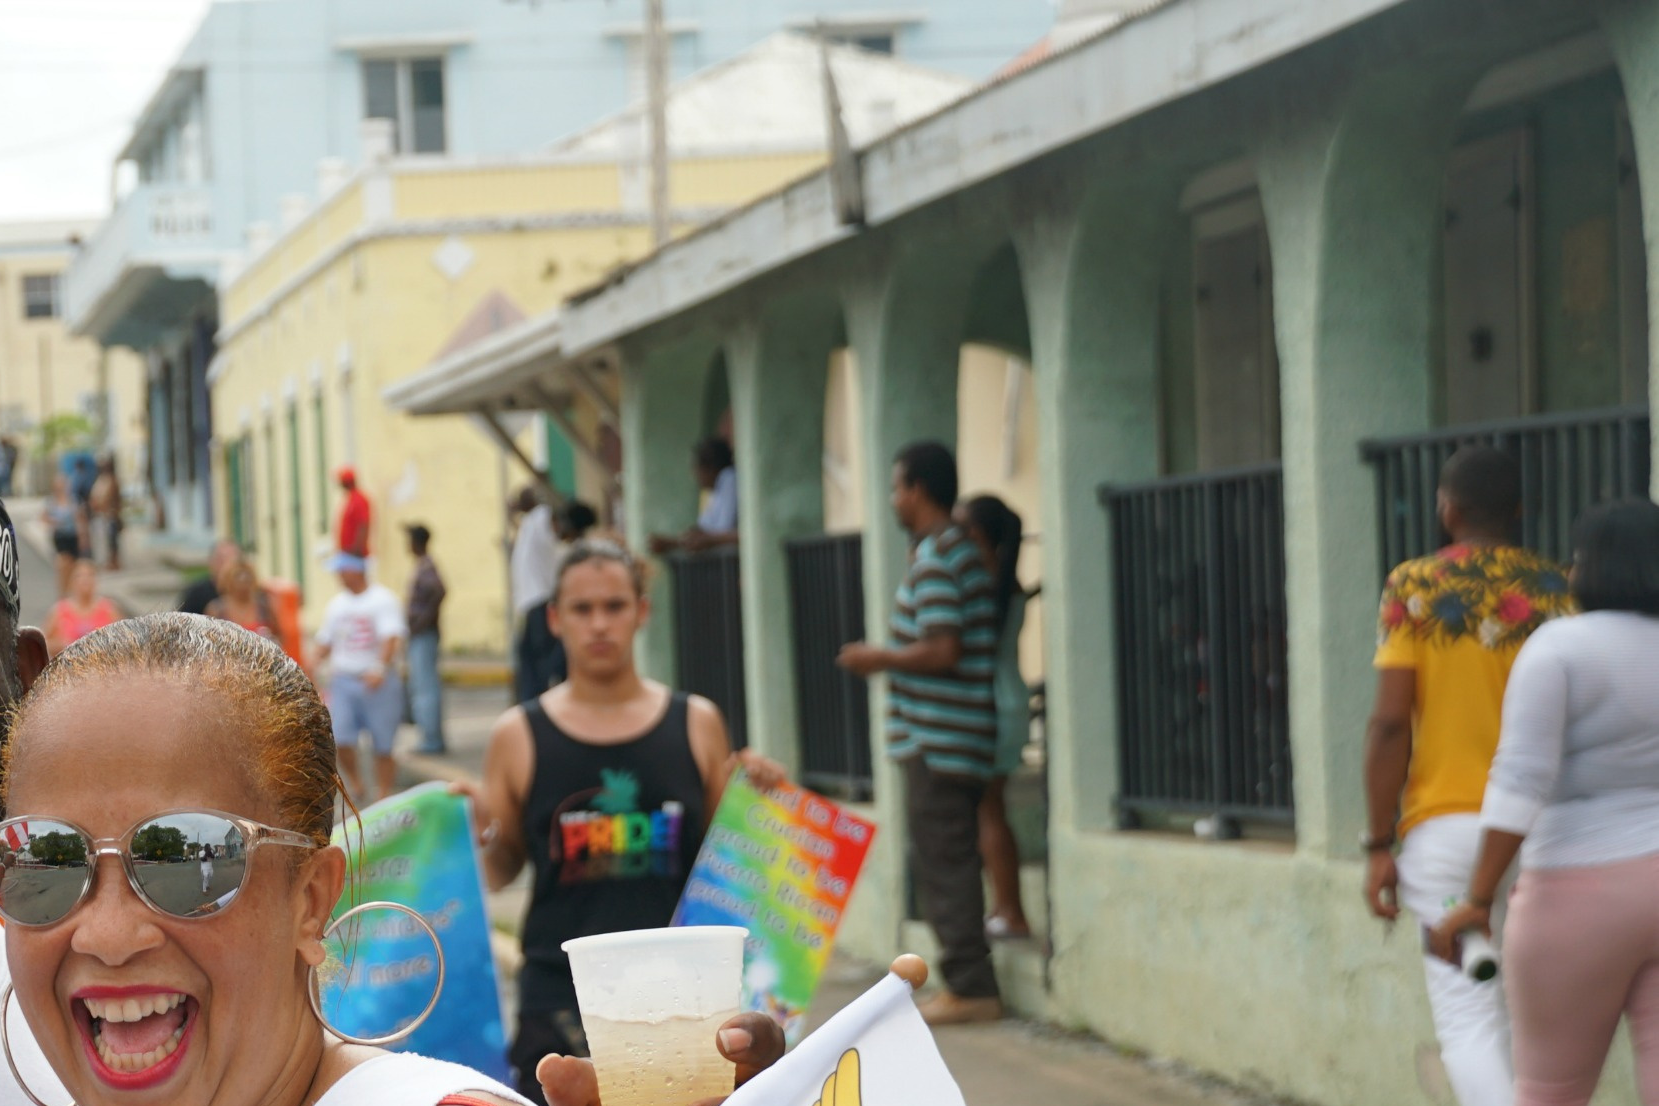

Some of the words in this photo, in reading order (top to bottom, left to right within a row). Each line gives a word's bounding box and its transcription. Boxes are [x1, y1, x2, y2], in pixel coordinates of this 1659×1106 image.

[833, 808, 868, 844] be
[708, 824, 780, 868] proud
[816, 865, 847, 897] be
[687, 876, 758, 920] proud
